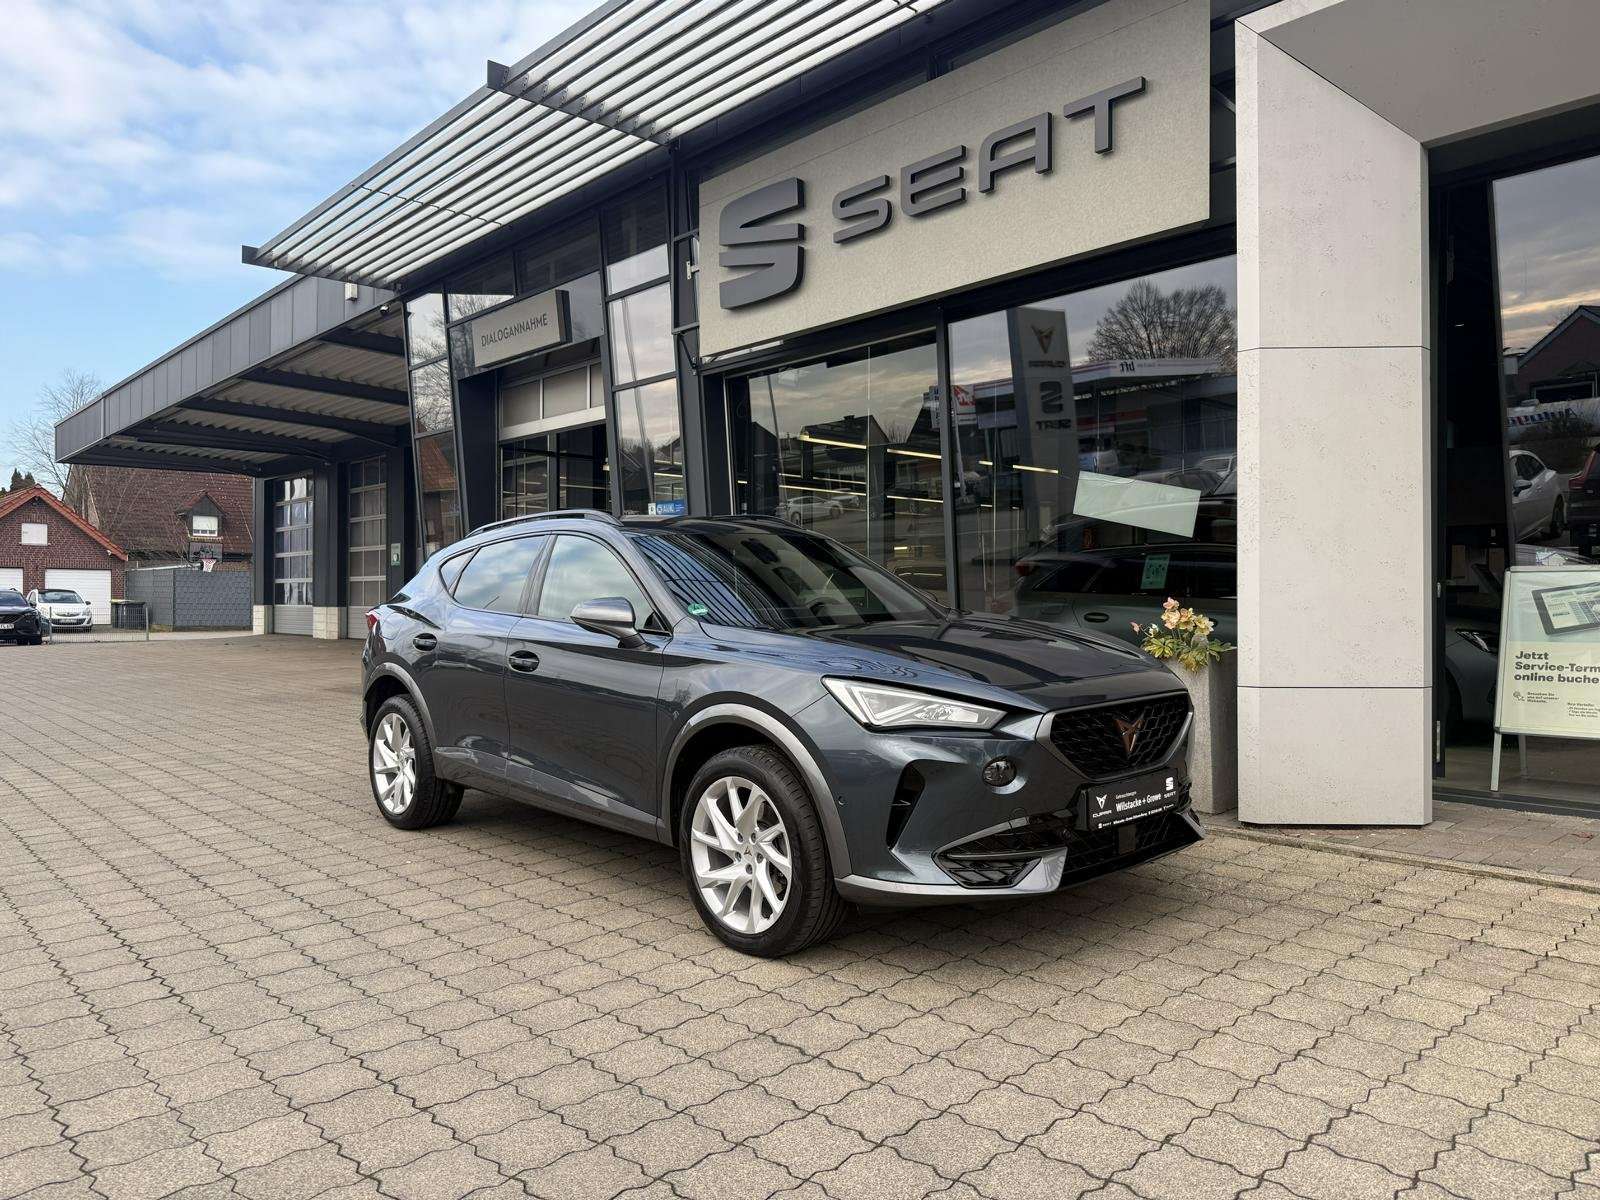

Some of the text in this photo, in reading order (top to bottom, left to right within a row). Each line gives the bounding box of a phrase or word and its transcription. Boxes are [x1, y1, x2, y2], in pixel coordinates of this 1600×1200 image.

[832, 76, 1146, 244] SEAT
[481, 313, 549, 347] DIALOGANNAHME
[1515, 651, 1549, 660] Jetzt
[1514, 672, 1600, 684] online buche
[1115, 798, 1142, 812] Wilstacke
[1146, 793, 1162, 803] Growe
